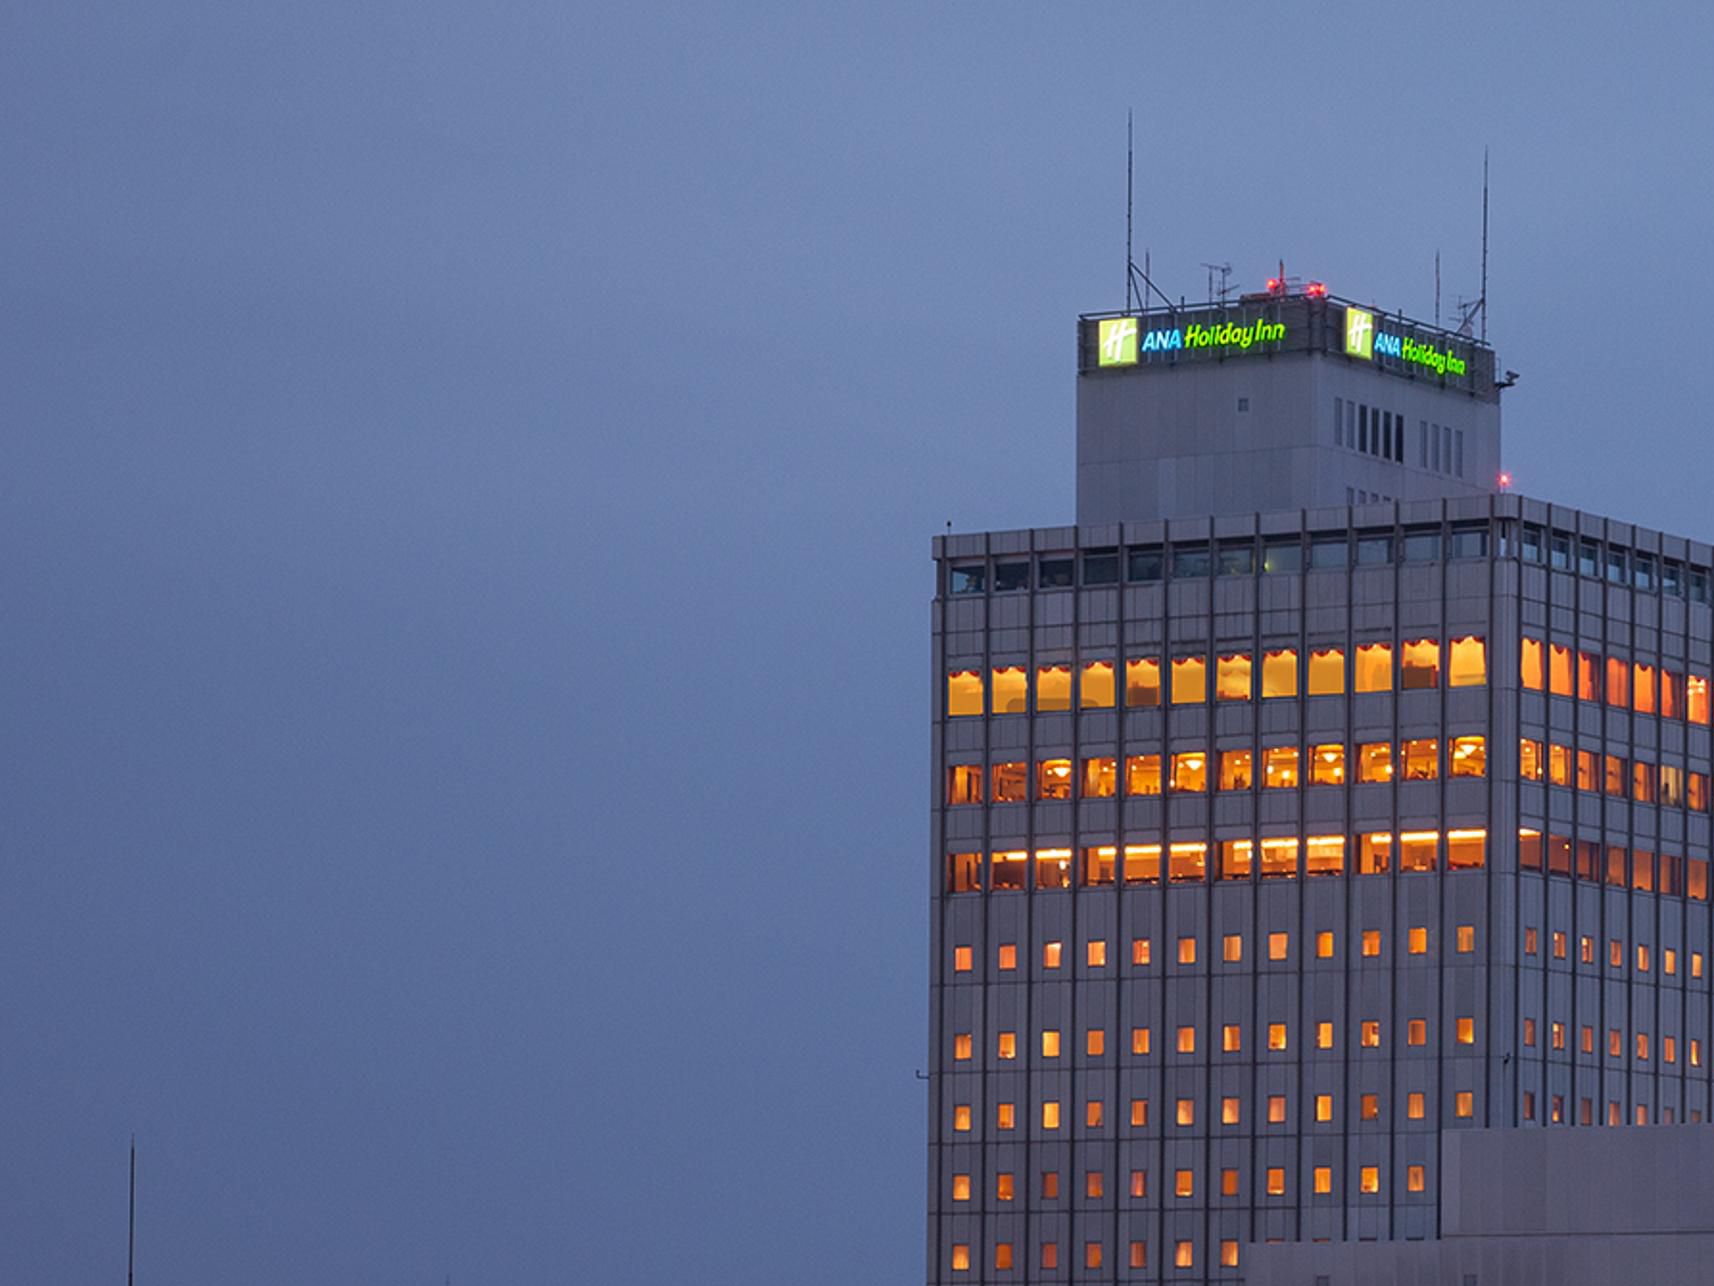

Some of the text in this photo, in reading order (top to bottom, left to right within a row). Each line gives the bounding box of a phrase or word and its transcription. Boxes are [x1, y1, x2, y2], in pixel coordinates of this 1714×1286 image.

[1141, 330, 1181, 352] ANA
[1185, 322, 1254, 349] Holiday
[1255, 318, 1285, 341] Inn
[1374, 331, 1401, 358] ANA
[1402, 336, 1446, 375] Holiday
